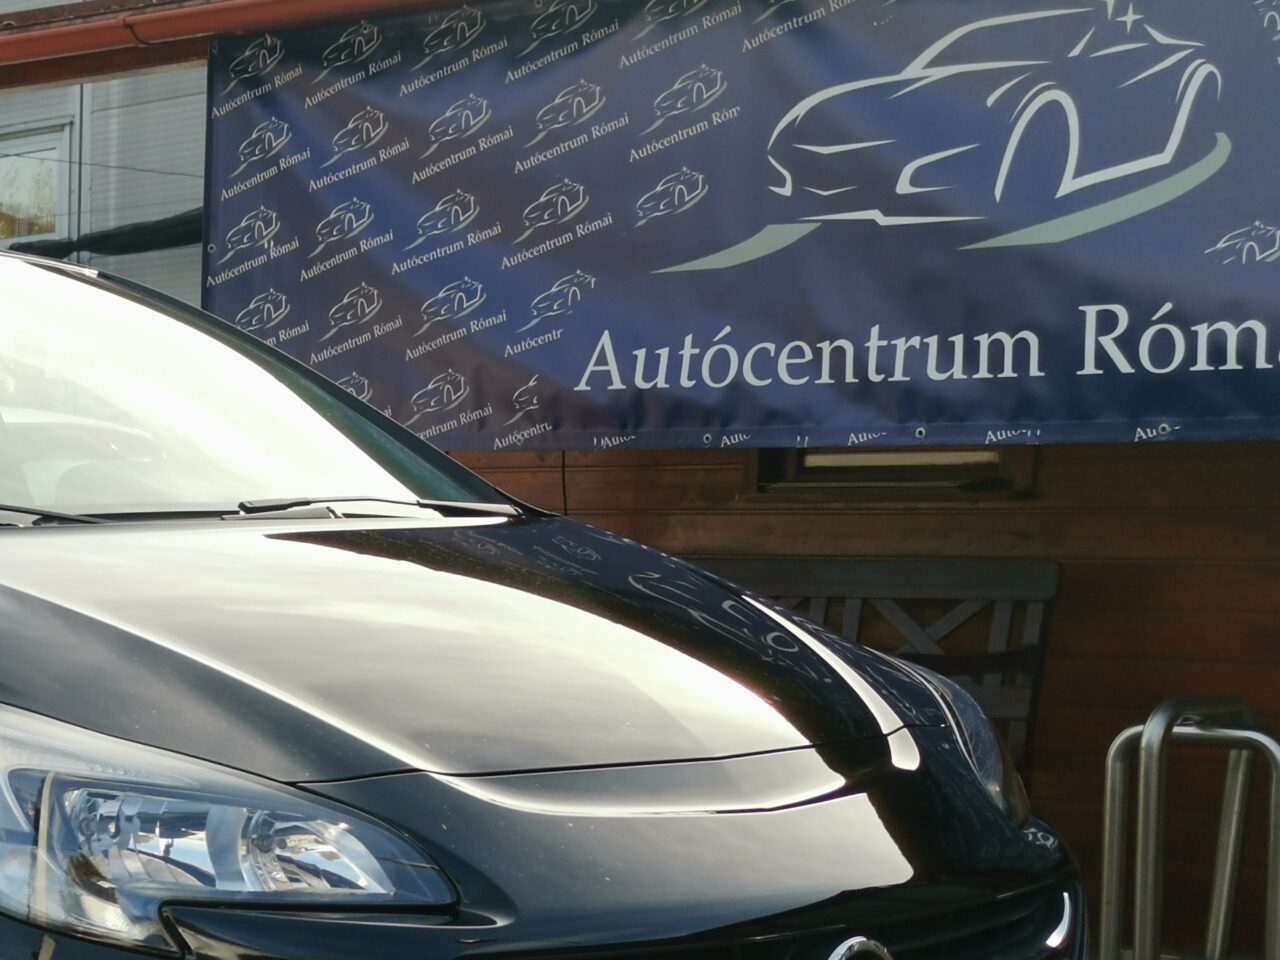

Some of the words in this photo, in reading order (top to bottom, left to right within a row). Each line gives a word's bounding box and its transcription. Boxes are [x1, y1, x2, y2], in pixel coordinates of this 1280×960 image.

[505, 42, 578, 84] Autócentrum
[582, 19, 619, 47] Római
[620, 23, 699, 69] Autócentrum
[702, 1, 742, 30] Római
[742, 7, 826, 53] Autócentrum
[211, 83, 272, 119] Autócentrum
[274, 64, 303, 88] Római
[304, 71, 366, 109] Autócentrum
[369, 51, 402, 75] Római
[399, 57, 469, 97] Autócentrum
[472, 36, 508, 61] Római
[309, 156, 377, 192] Autócentrum
[379, 137, 409, 161] Római
[412, 147, 477, 184] Autócentrum
[479, 125, 514, 153] Római
[514, 132, 588, 174] Autócentrum
[592, 112, 629, 139] Római
[629, 120, 709, 162] Autócentrum
[221, 165, 277, 201] Autócentrum
[279, 147, 311, 171] Római
[206, 253, 268, 288] Autócentrum
[270, 236, 300, 259] Római
[300, 248, 358, 282] Autócentrum
[360, 229, 394, 253] Római
[391, 238, 464, 276] Autócentrum
[467, 221, 502, 246] Római
[501, 231, 573, 270] Autócentrum
[576, 213, 613, 238] Római
[279, 320, 310, 343] Római
[310, 331, 371, 365] Autócentrum
[374, 315, 403, 337] Római
[405, 326, 468, 361] Autócentrum
[471, 310, 507, 333] Római
[574, 324, 1045, 391] Autócentrum
[1076, 302, 1280, 375] Róm
[460, 402, 492, 425] Római
